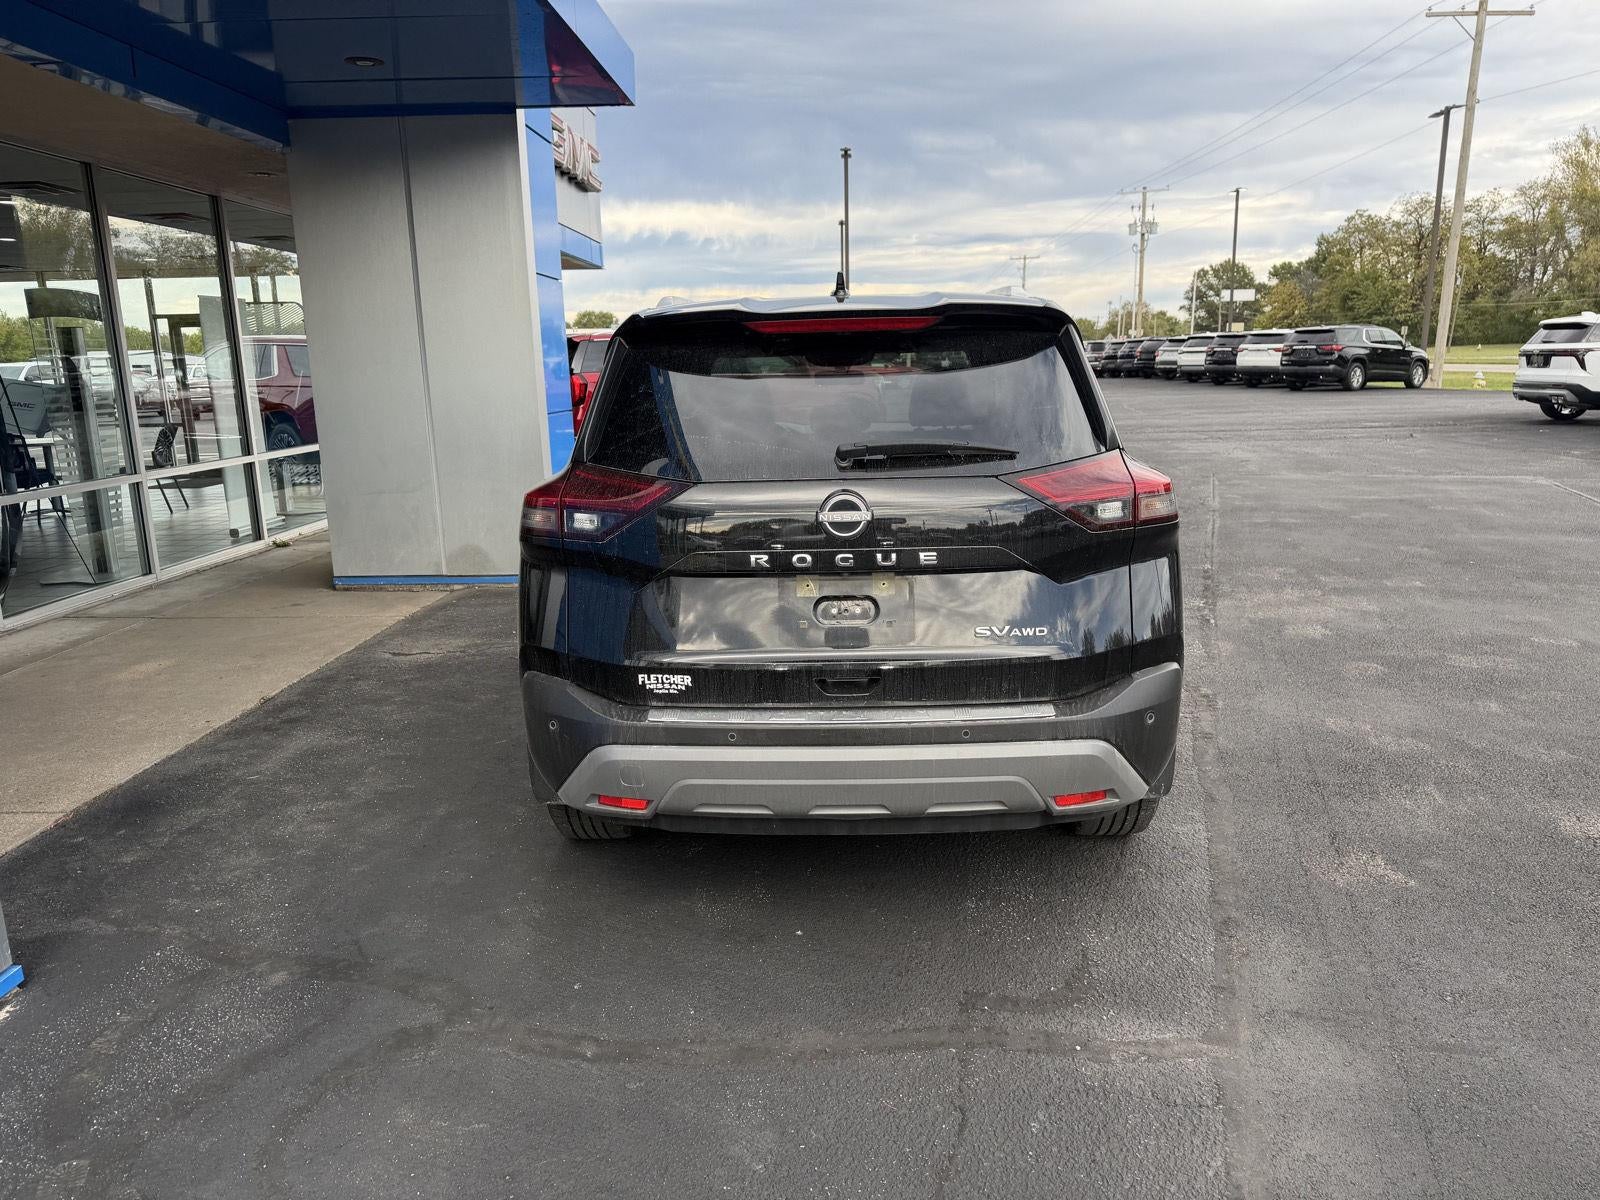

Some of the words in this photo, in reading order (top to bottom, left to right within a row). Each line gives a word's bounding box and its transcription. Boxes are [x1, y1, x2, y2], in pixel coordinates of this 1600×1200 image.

[819, 513, 871, 521] NISSAN
[750, 551, 938, 568] ROGUE
[638, 674, 692, 686] FLETCHER
